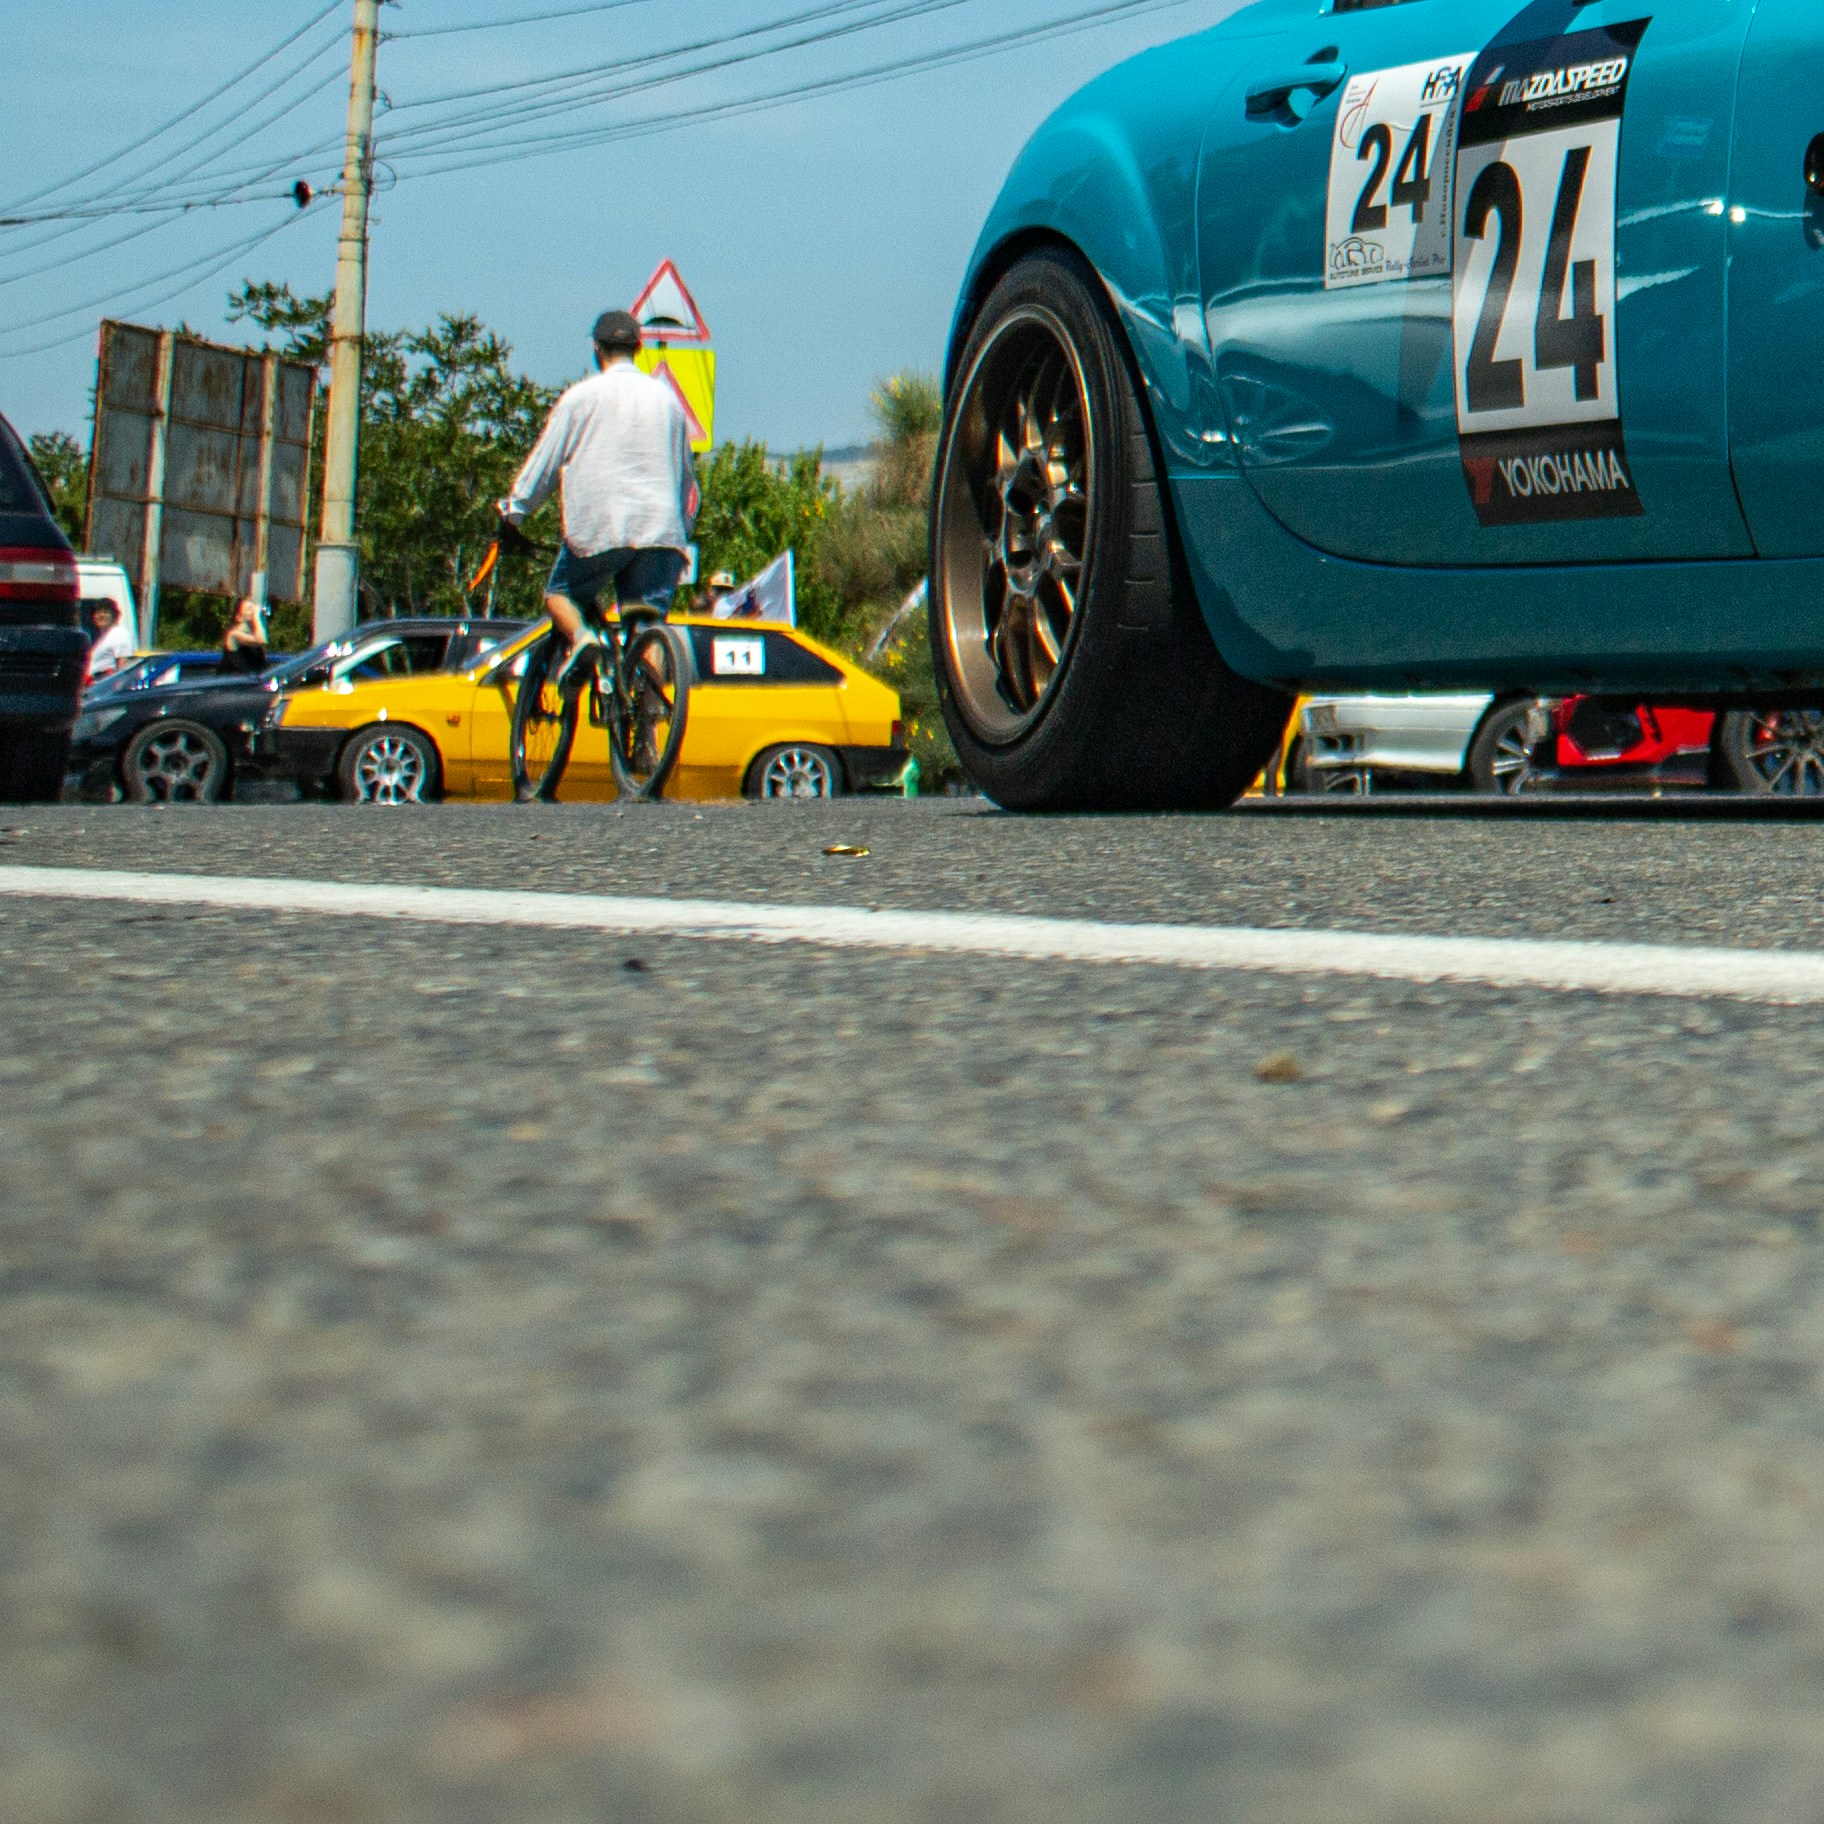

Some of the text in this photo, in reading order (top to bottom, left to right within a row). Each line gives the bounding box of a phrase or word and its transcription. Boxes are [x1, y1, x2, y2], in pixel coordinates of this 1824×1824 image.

[1499, 57, 1629, 106] MAZDASPEED
[1351, 113, 1432, 233] 24
[1463, 145, 1605, 413] 24
[1498, 449, 1629, 497] YOKOHAMA
[726, 650, 751, 666] 11
